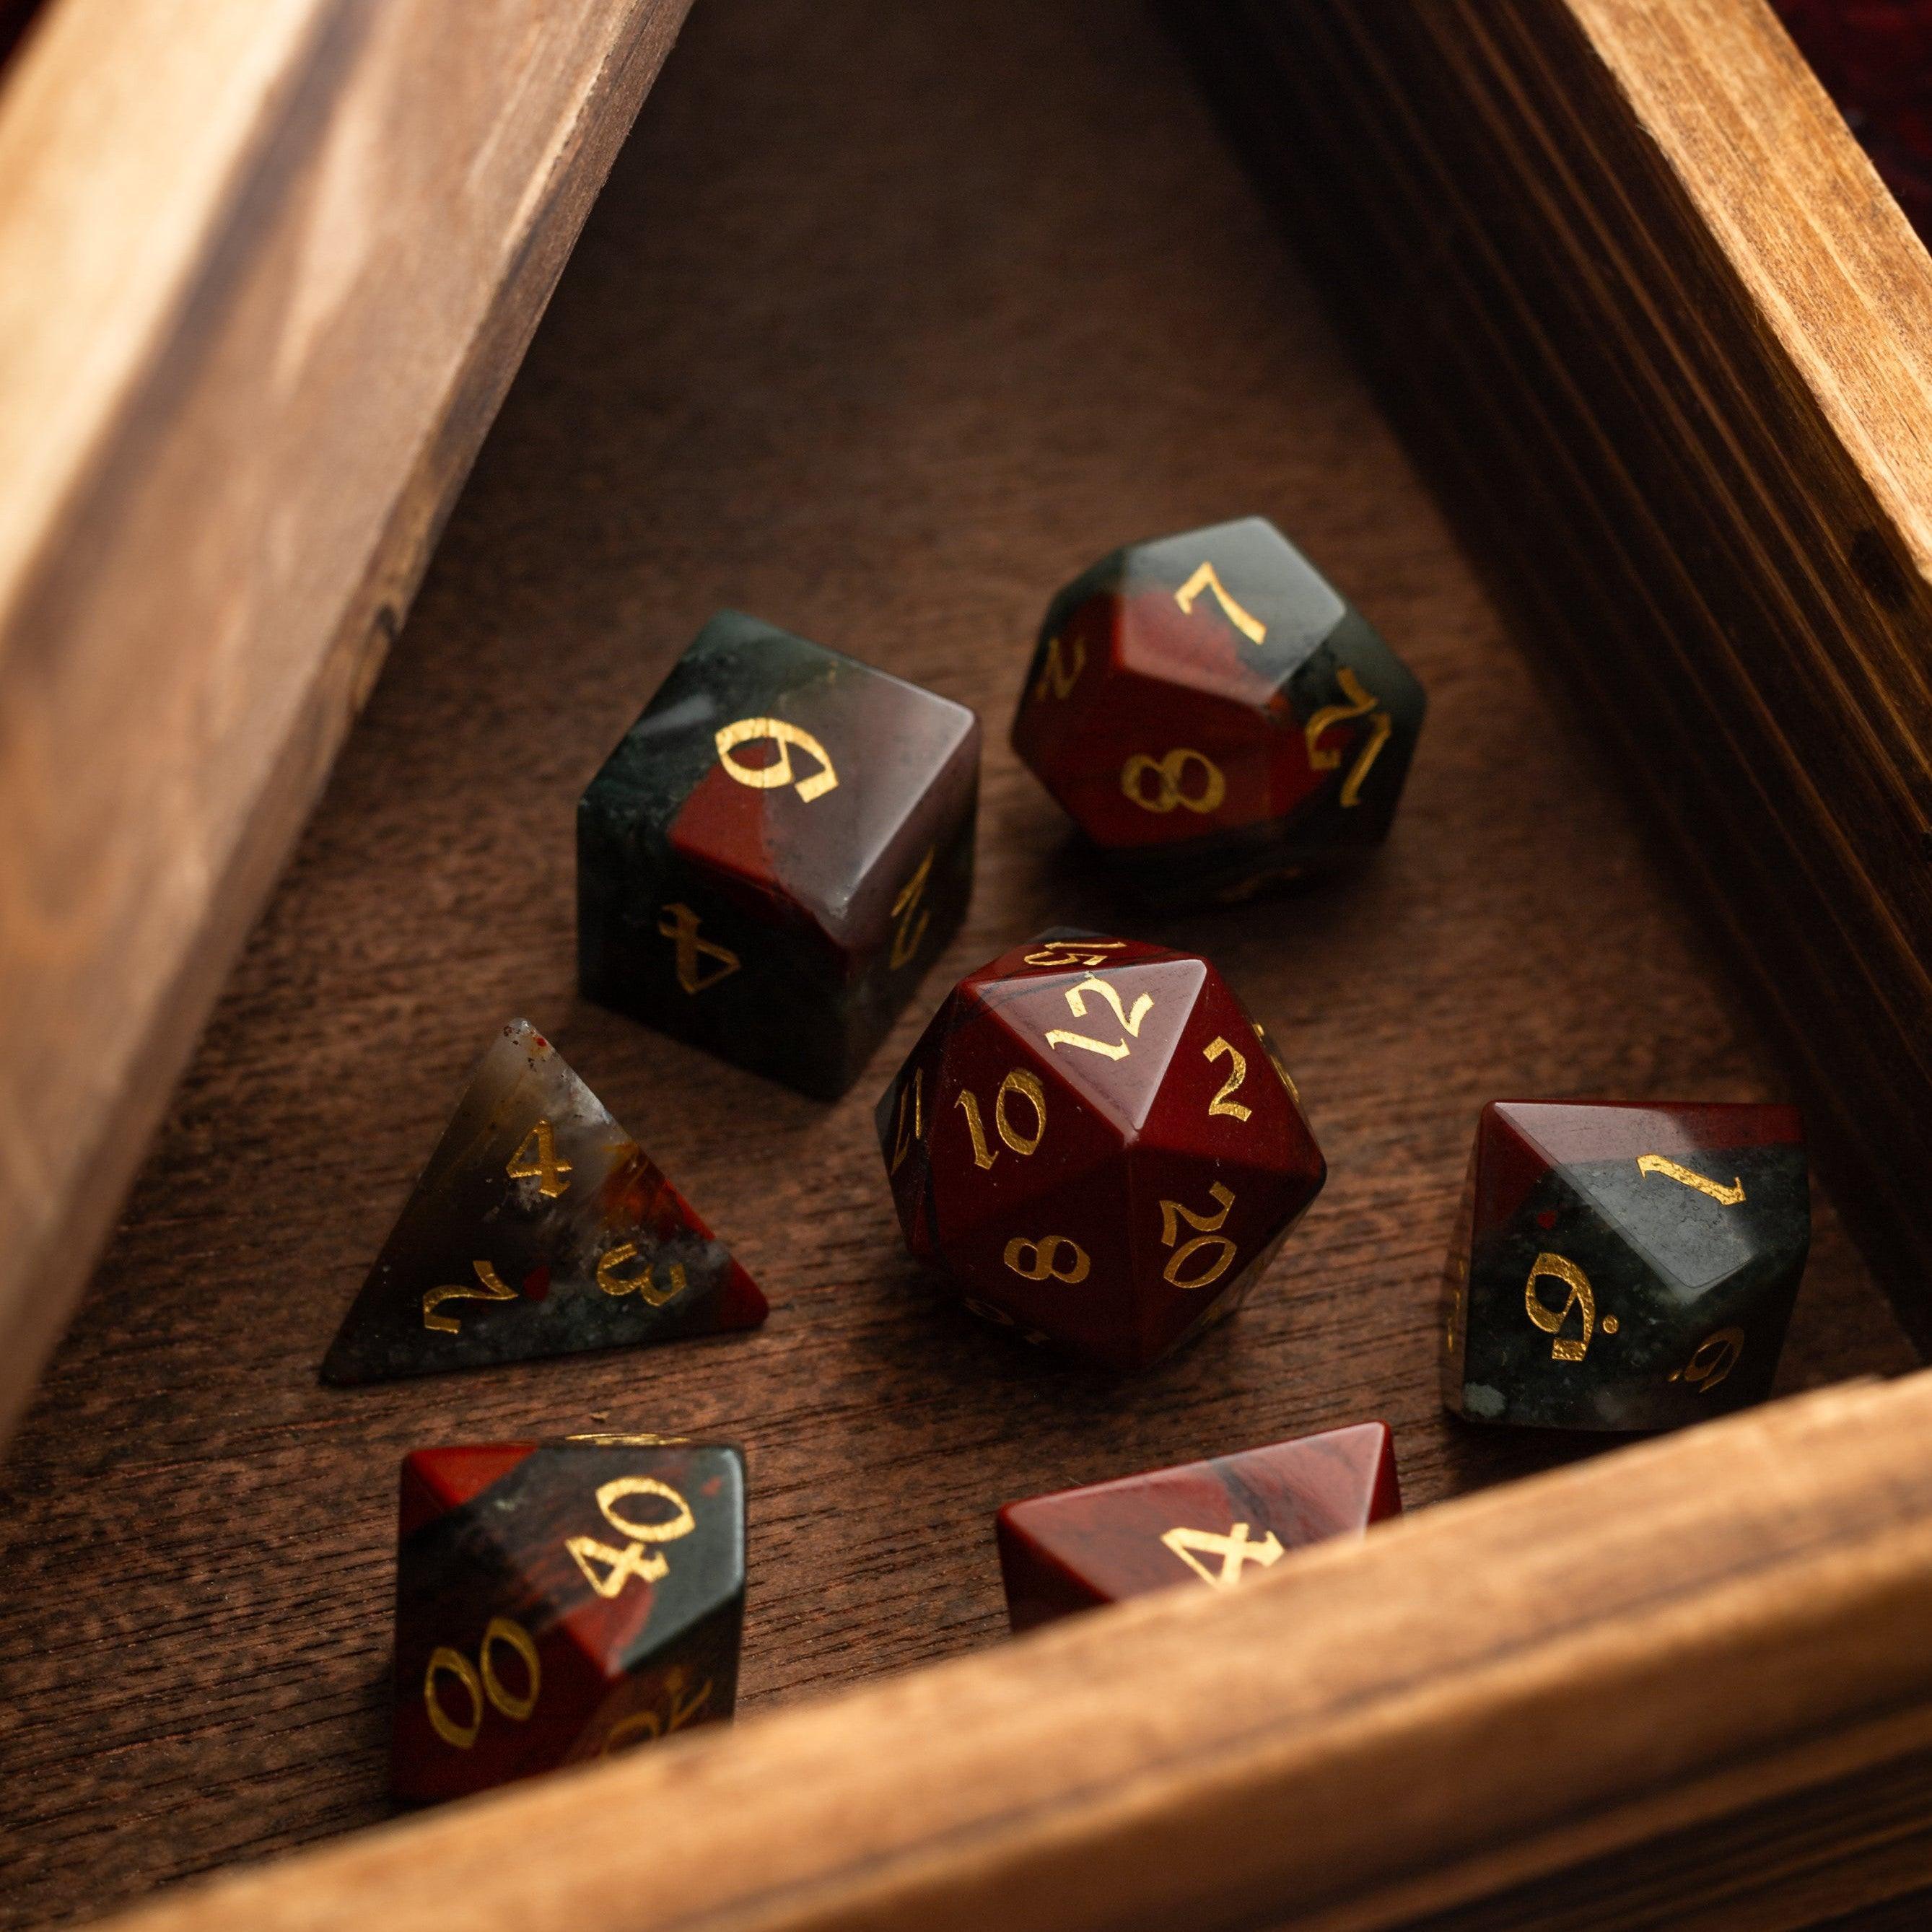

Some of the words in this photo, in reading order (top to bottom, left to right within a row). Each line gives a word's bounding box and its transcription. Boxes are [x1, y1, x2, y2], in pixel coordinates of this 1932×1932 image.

[1174, 560, 1267, 645] 7
[1121, 746, 1226, 815] 8
[657, 901, 742, 996] 4
[1044, 971, 1155, 1062] 12
[954, 1067, 1047, 1171] 10
[1202, 1035, 1253, 1123] 2
[506, 1119, 573, 1199] 4
[1635, 1153, 1747, 1207] 1
[595, 1241, 688, 1308] 3
[1003, 1235, 1092, 1285] 8
[1159, 1179, 1238, 1289] 20
[423, 1260, 520, 1336] 2
[565, 1475, 696, 1599] 40
[1160, 1521, 1285, 1591] 4
[424, 1616, 542, 1750] 00
